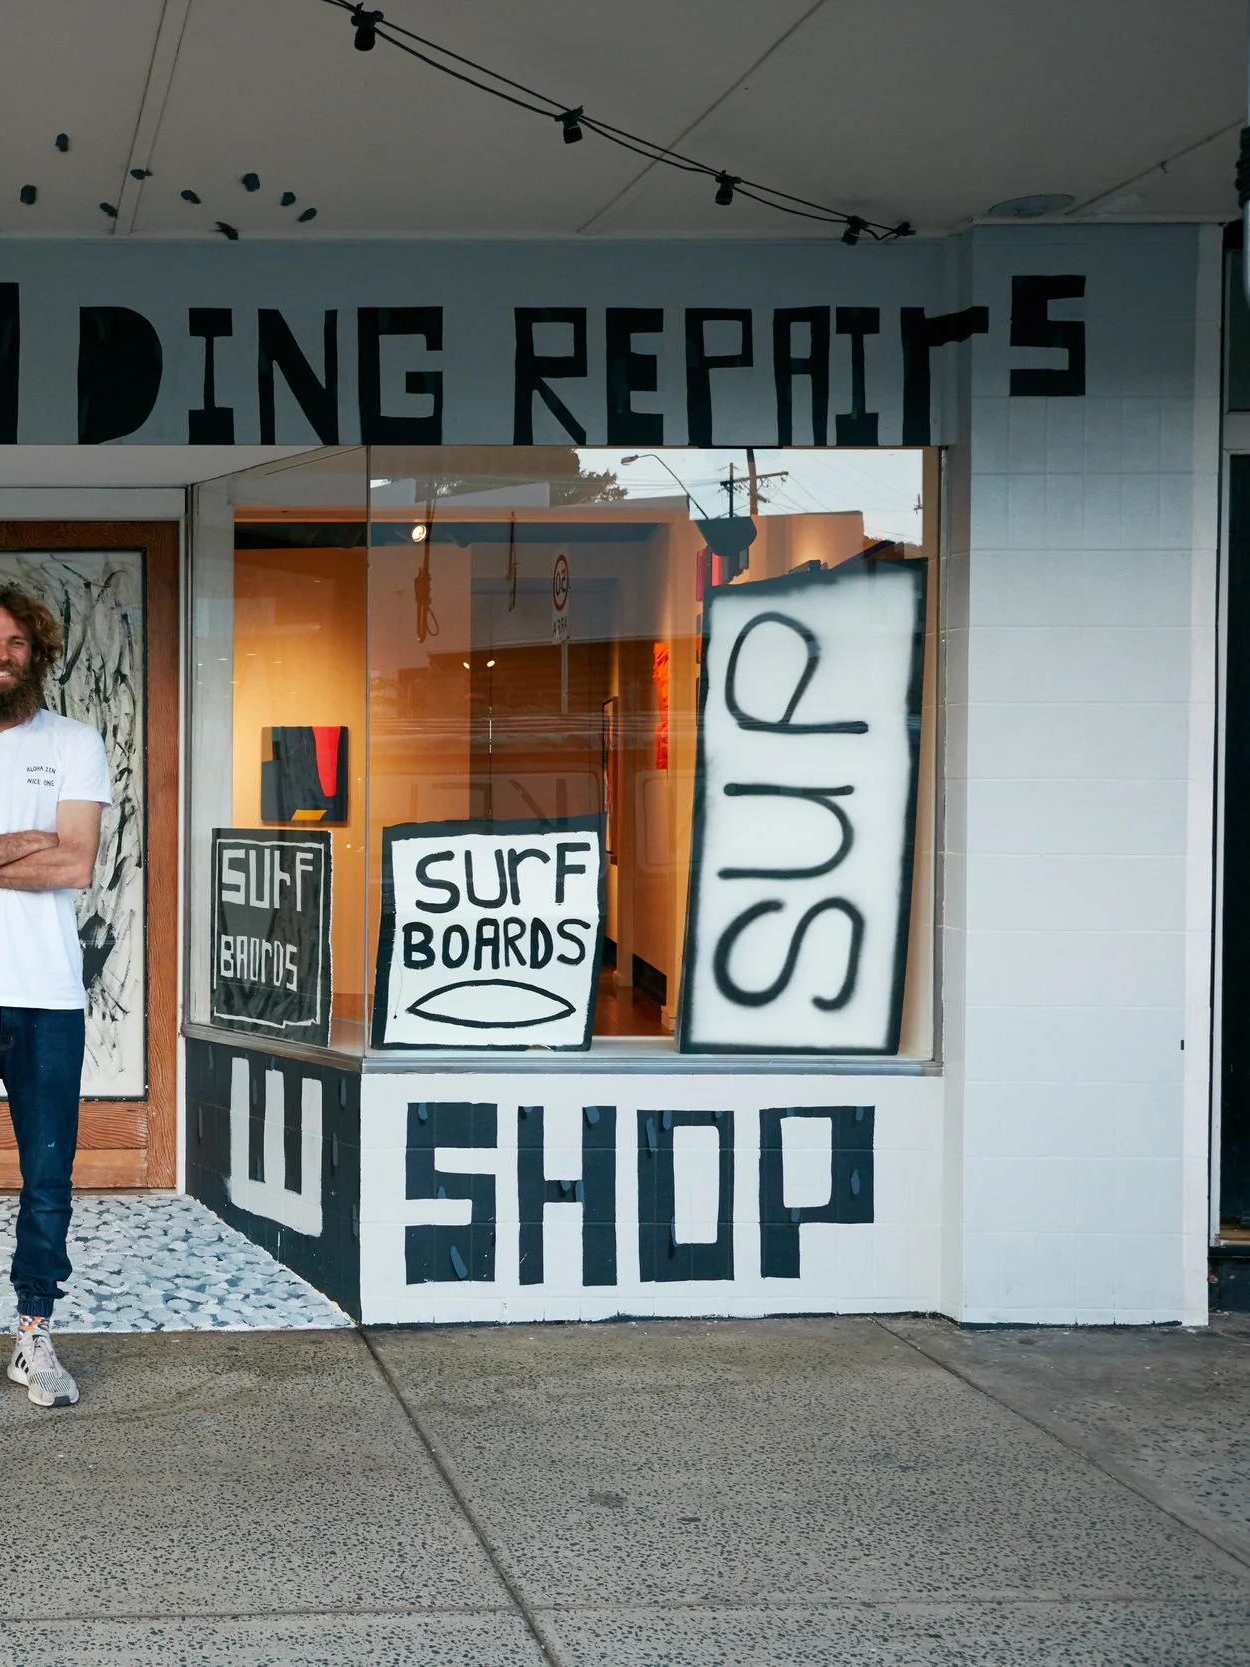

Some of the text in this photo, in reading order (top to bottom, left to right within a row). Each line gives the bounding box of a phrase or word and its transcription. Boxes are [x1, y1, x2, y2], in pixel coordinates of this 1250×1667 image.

[78, 306, 444, 446] DING
[713, 611, 869, 1012] SUP
[402, 917, 591, 970] BOARDS
[404, 1101, 876, 1287] SHOP
